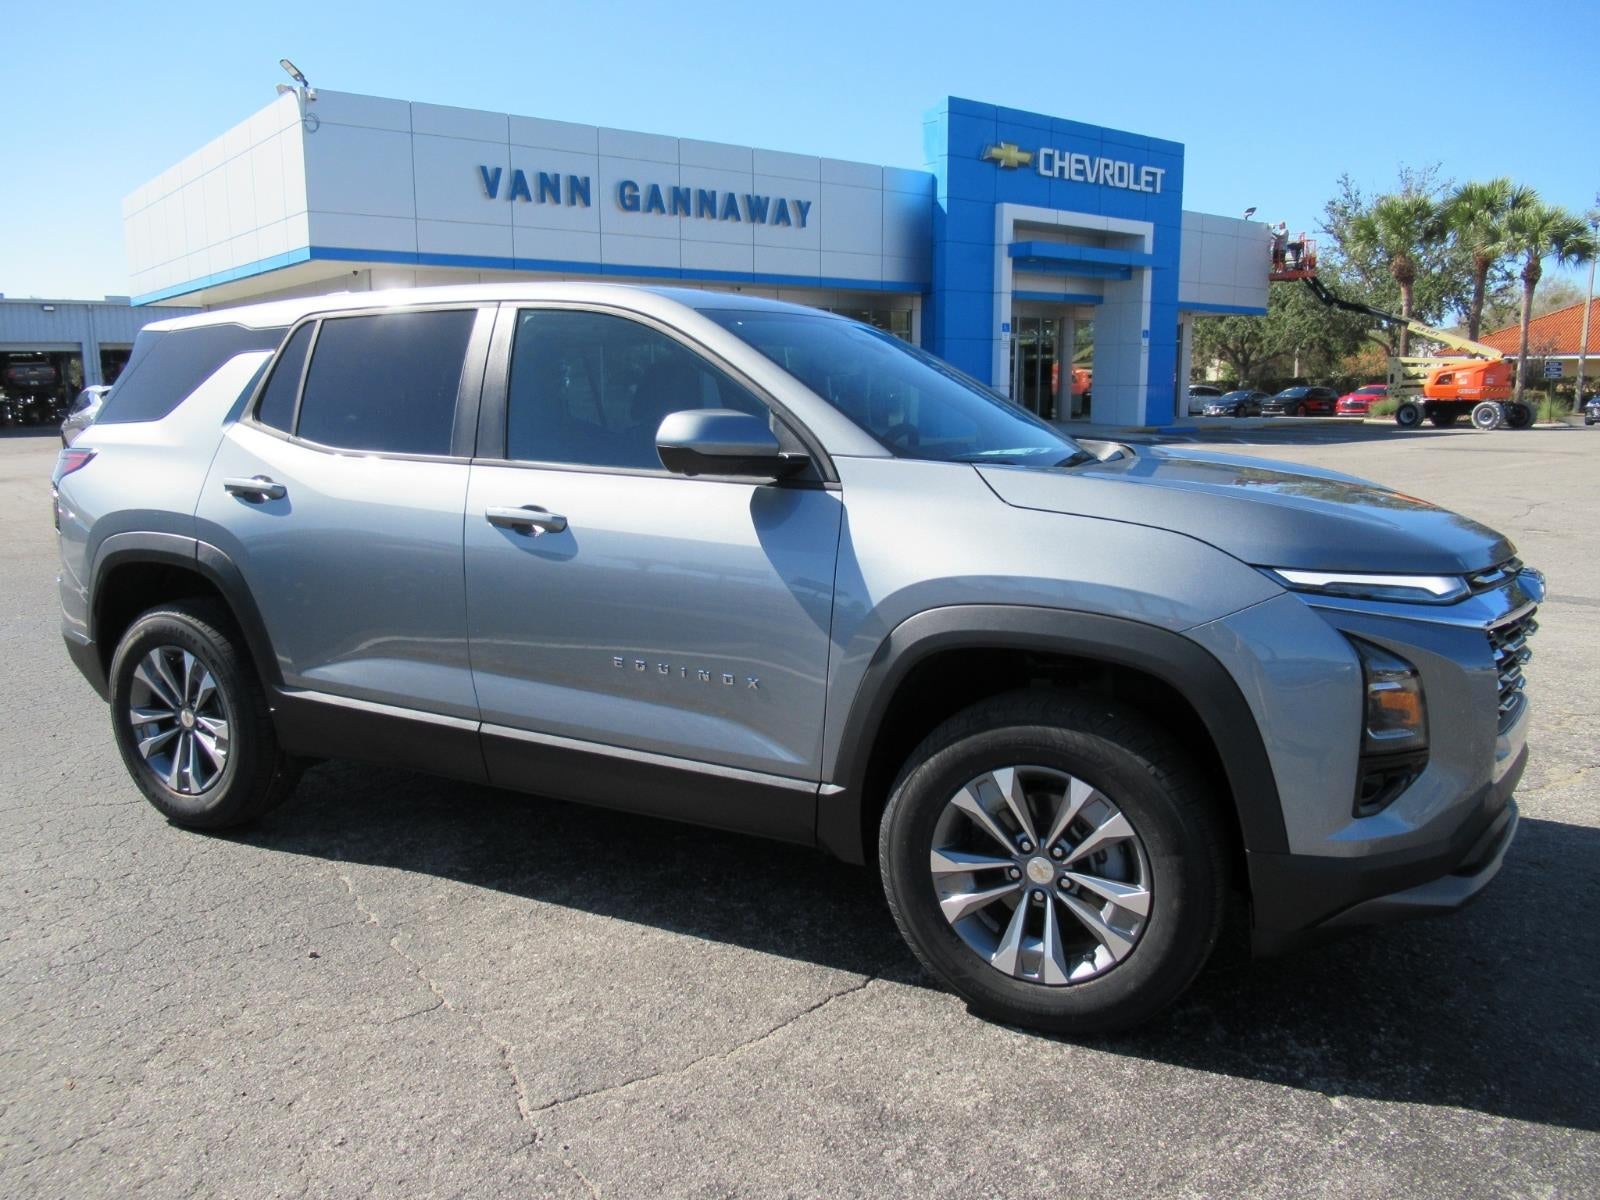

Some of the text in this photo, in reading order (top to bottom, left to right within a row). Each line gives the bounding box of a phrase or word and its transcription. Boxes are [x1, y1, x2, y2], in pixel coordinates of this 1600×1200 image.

[1038, 147, 1165, 193] CHEVROLET
[479, 164, 812, 228] VANN GANNAWAY
[613, 656, 759, 689] EQUINOX
